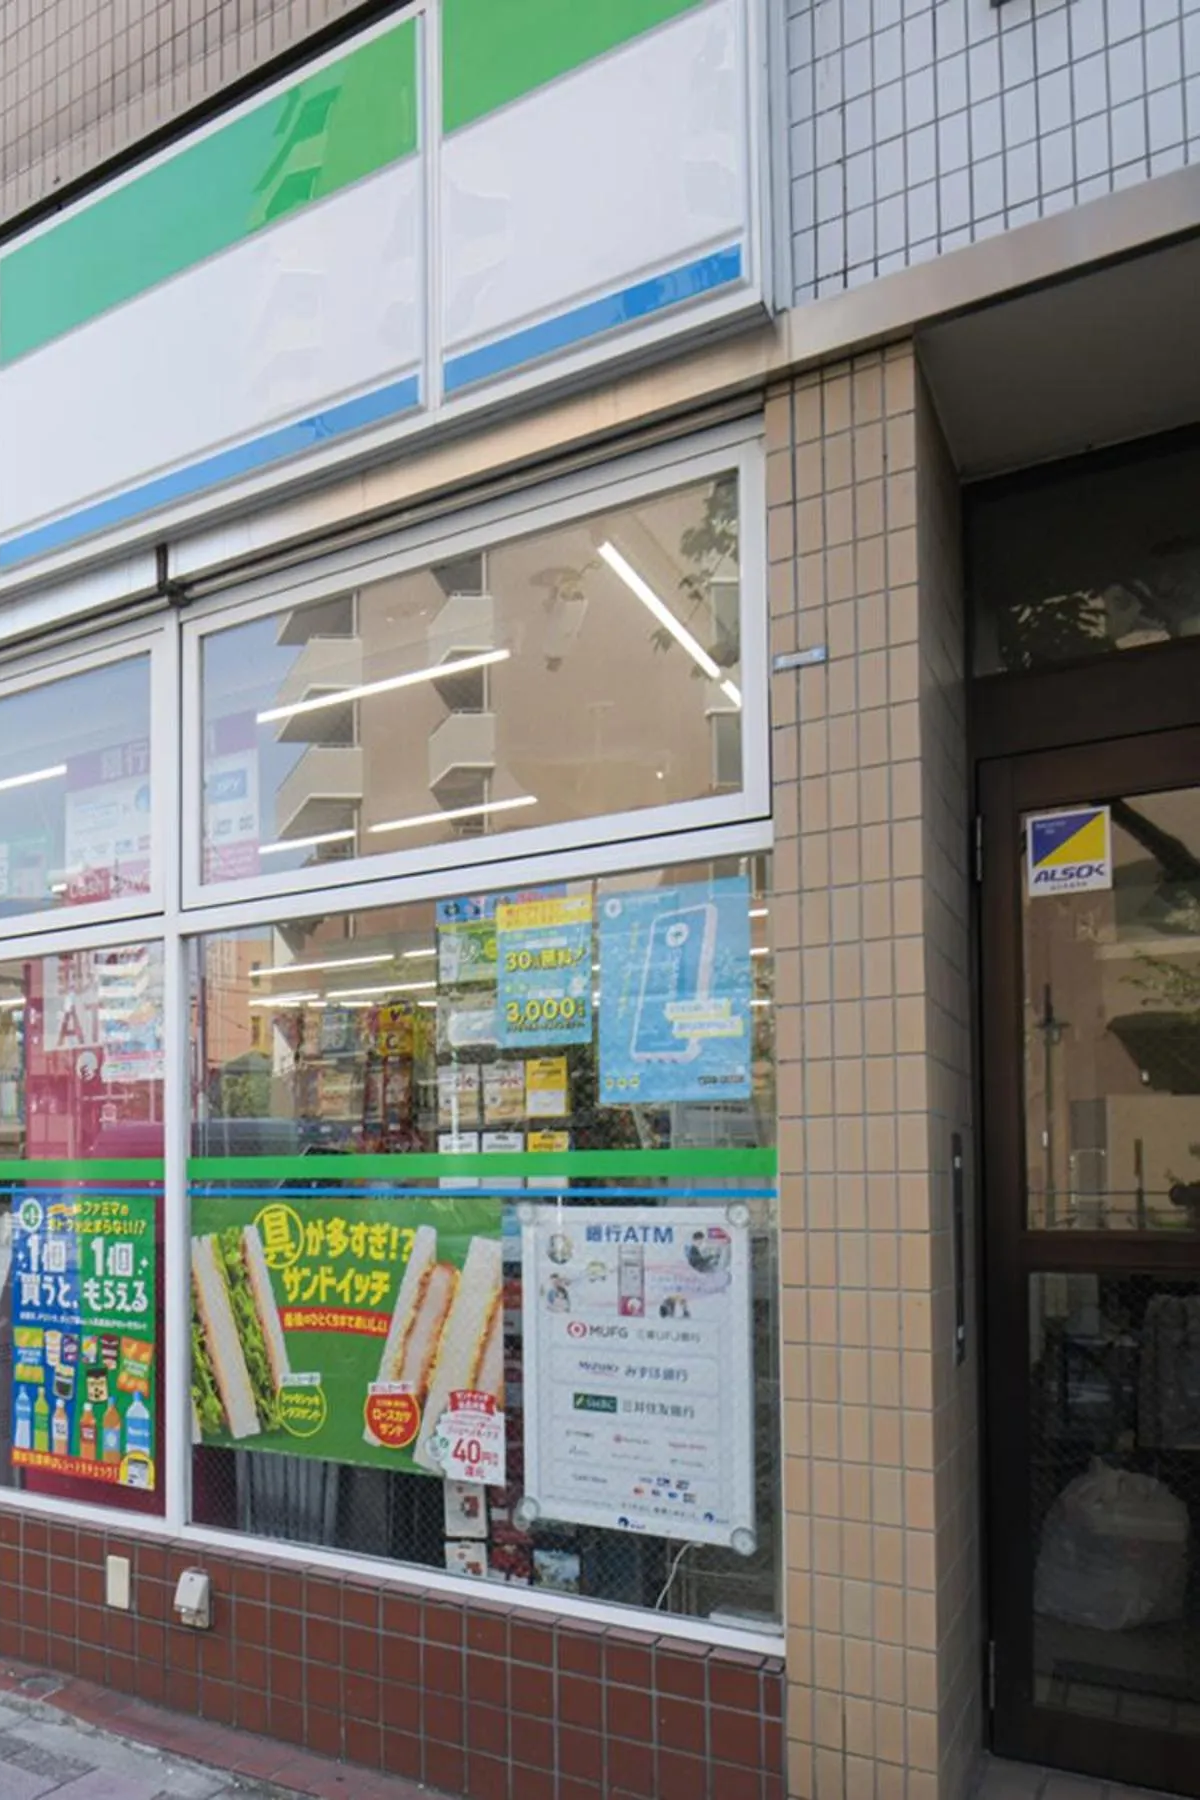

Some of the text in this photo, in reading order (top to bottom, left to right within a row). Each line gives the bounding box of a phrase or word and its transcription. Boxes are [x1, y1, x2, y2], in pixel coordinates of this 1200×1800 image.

[1034, 863, 1104, 883] ALSOK
[586, 1225, 674, 1244] 銀行ATM
[27, 1234, 66, 1273] 1個
[90, 1237, 134, 1277] 1個
[83, 1278, 149, 1313] もらえる
[282, 1266, 391, 1305] サンドイッチ
[589, 1325, 629, 1339] MUFG
